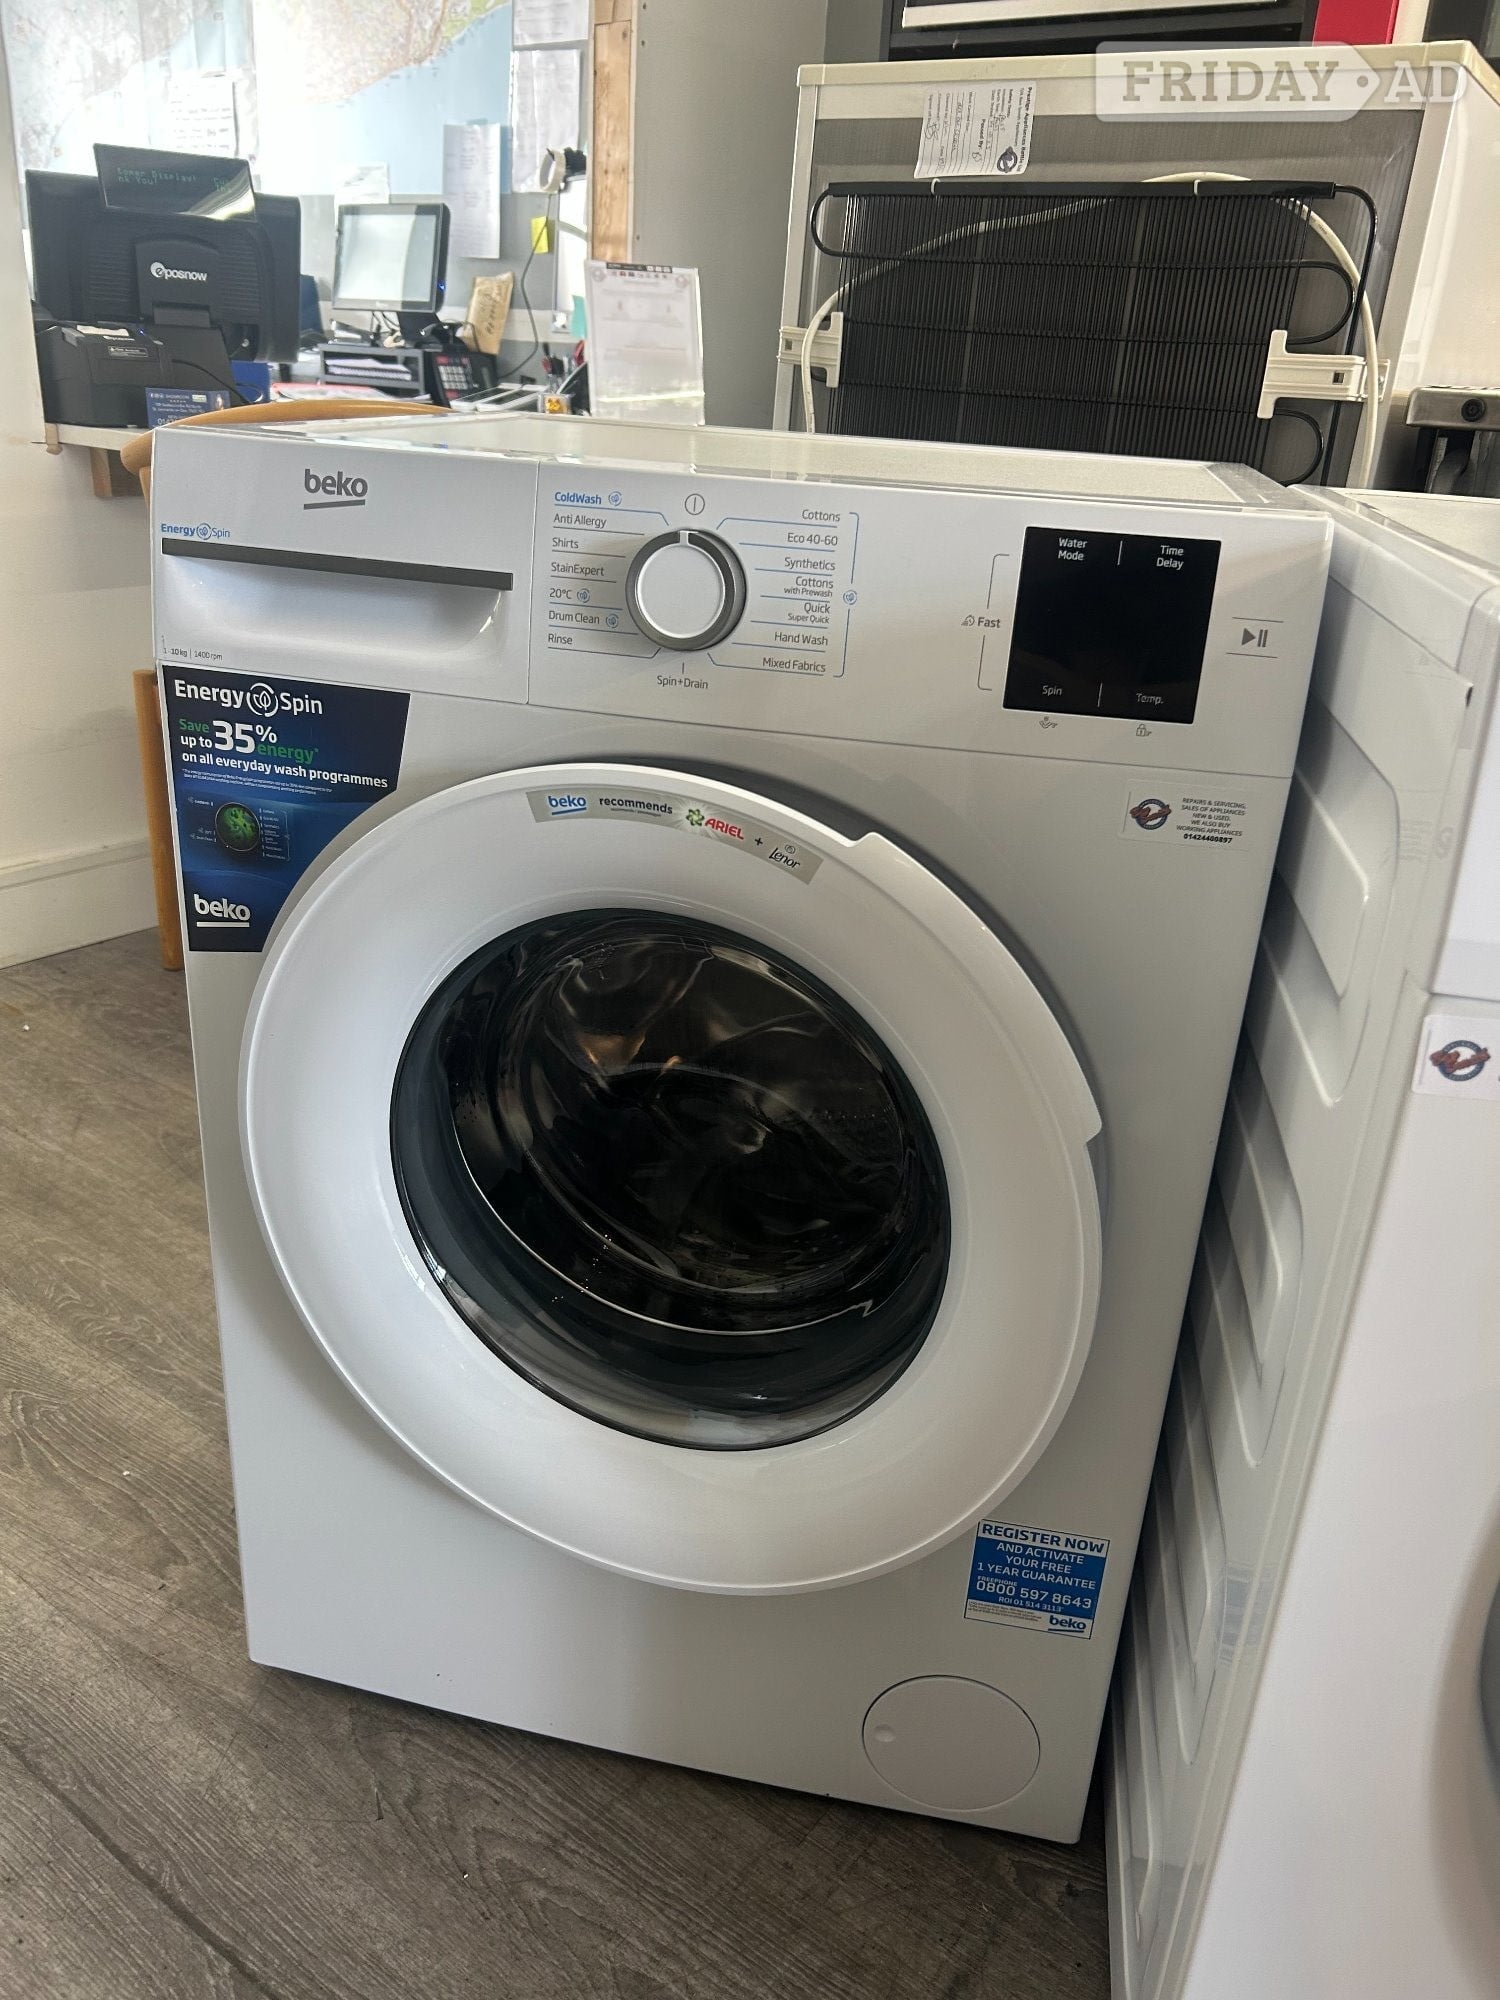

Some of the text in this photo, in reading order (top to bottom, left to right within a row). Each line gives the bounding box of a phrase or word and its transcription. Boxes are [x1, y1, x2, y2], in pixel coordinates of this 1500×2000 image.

[1020, 112, 1031, 146] Appliances
[150, 262, 207, 281] eposnow
[304, 468, 368, 498] beko
[554, 491, 602, 505] ColdWash
[553, 513, 607, 529] Anti Allergy
[802, 509, 841, 522] Cottons
[161, 523, 231, 538] Energy Spin
[552, 537, 579, 549] Shirts
[787, 532, 838, 546] Eco 40-60
[1058, 537, 1088, 549] Water
[1057, 550, 1084, 561] Mode
[1160, 544, 1184, 556] Time
[551, 562, 605, 576] StainExpert
[784, 557, 836, 571] Synthetics
[1156, 557, 1184, 571] Delay
[795, 576, 834, 589] Cottons
[783, 587, 833, 598] with Prewash
[803, 602, 831, 614] Quick
[548, 610, 600, 624] Drum Clean
[787, 613, 830, 624] Super Quick
[977, 617, 1000, 629] Fast
[548, 633, 573, 645] Rinse
[774, 631, 828, 646] Hand Wash
[762, 657, 826, 673] Mixed Fabrics
[656, 675, 709, 689] Spin+Drain
[174, 679, 323, 716] Energy Spin
[1041, 684, 1063, 697] Spin
[1135, 692, 1164, 705] Temp.
[178, 718, 210, 734] Save
[180, 735, 197, 748] up
[198, 735, 213, 749] to
[212, 720, 278, 754] 35%
[182, 752, 198, 763] on
[199, 753, 213, 765] all
[215, 757, 272, 775] everyday
[274, 764, 306, 778] wash
[309, 769, 389, 788] programmes
[1182, 797, 1207, 805] REPAIRS
[1209, 807, 1246, 816] APPLIANCES
[547, 795, 587, 808] beko
[599, 797, 673, 815] recommends
[704, 818, 744, 840] ARIEL
[768, 847, 801, 869] Lenor
[1176, 825, 1243, 837] WORKING APPLIANCES
[193, 893, 251, 921] beko
[982, 1523, 1105, 1554] REGISTER NOW
[996, 1542, 1085, 1565] AND ACTIVATE
[1005, 1555, 1072, 1574] YOUR FREE
[977, 1562, 1096, 1590] 1 YEAR GUARANTEE
[977, 1575, 1018, 1587] FREEPHONE
[976, 1580, 1092, 1609] 0800 597 8643
[998, 1596, 1013, 1604] ROI
[1049, 1615, 1087, 1630] beko
